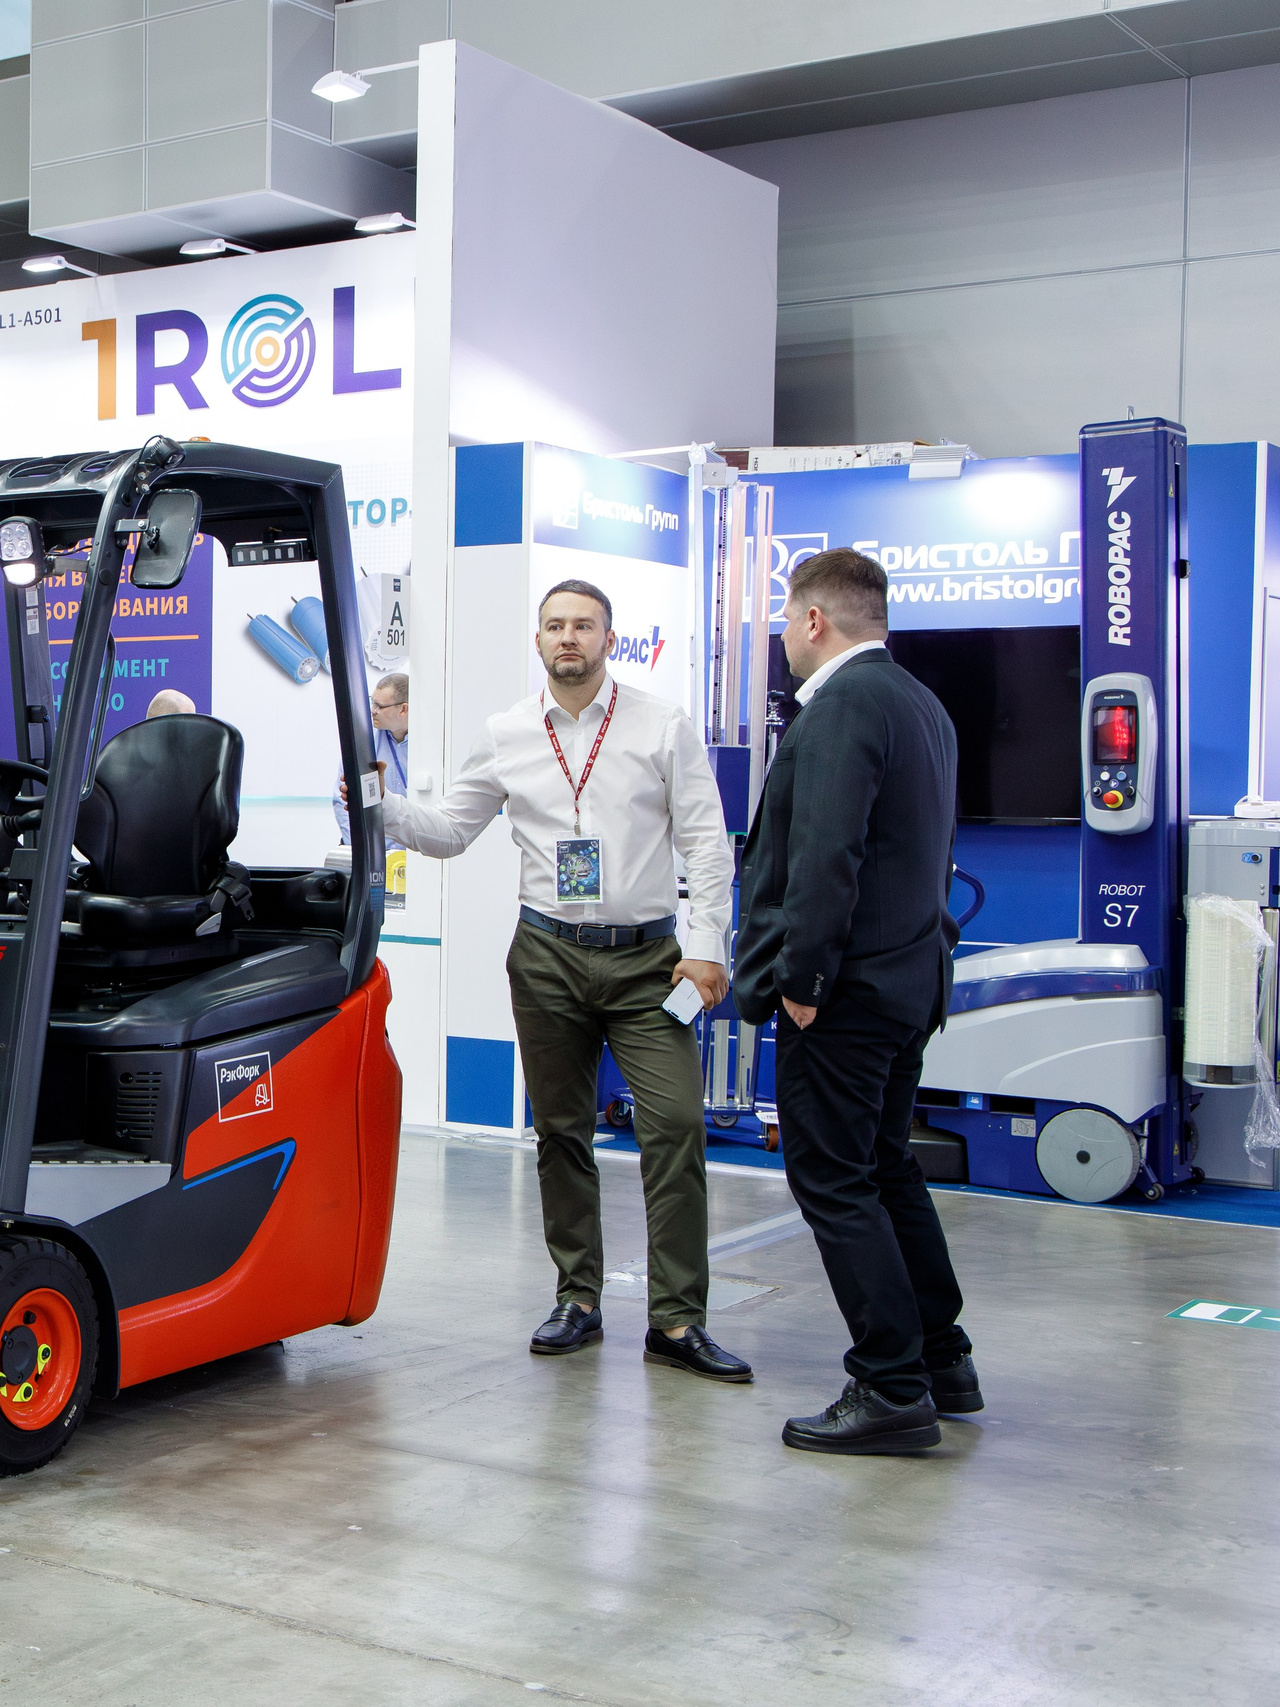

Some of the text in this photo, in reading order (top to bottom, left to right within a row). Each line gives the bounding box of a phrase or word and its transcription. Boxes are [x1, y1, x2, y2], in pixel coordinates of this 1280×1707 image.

[582, 491, 644, 525] Бристоль
[644, 503, 679, 532] Групп
[887, 573, 1080, 604] ww.bristolgr
[1108, 511, 1131, 646] ROBOPAC
[390, 601, 404, 627] A
[386, 629, 405, 646] 501
[1098, 884, 1146, 896] ROBOT
[1103, 903, 1139, 928] S7
[220, 1064, 260, 1083] РэкФорк
